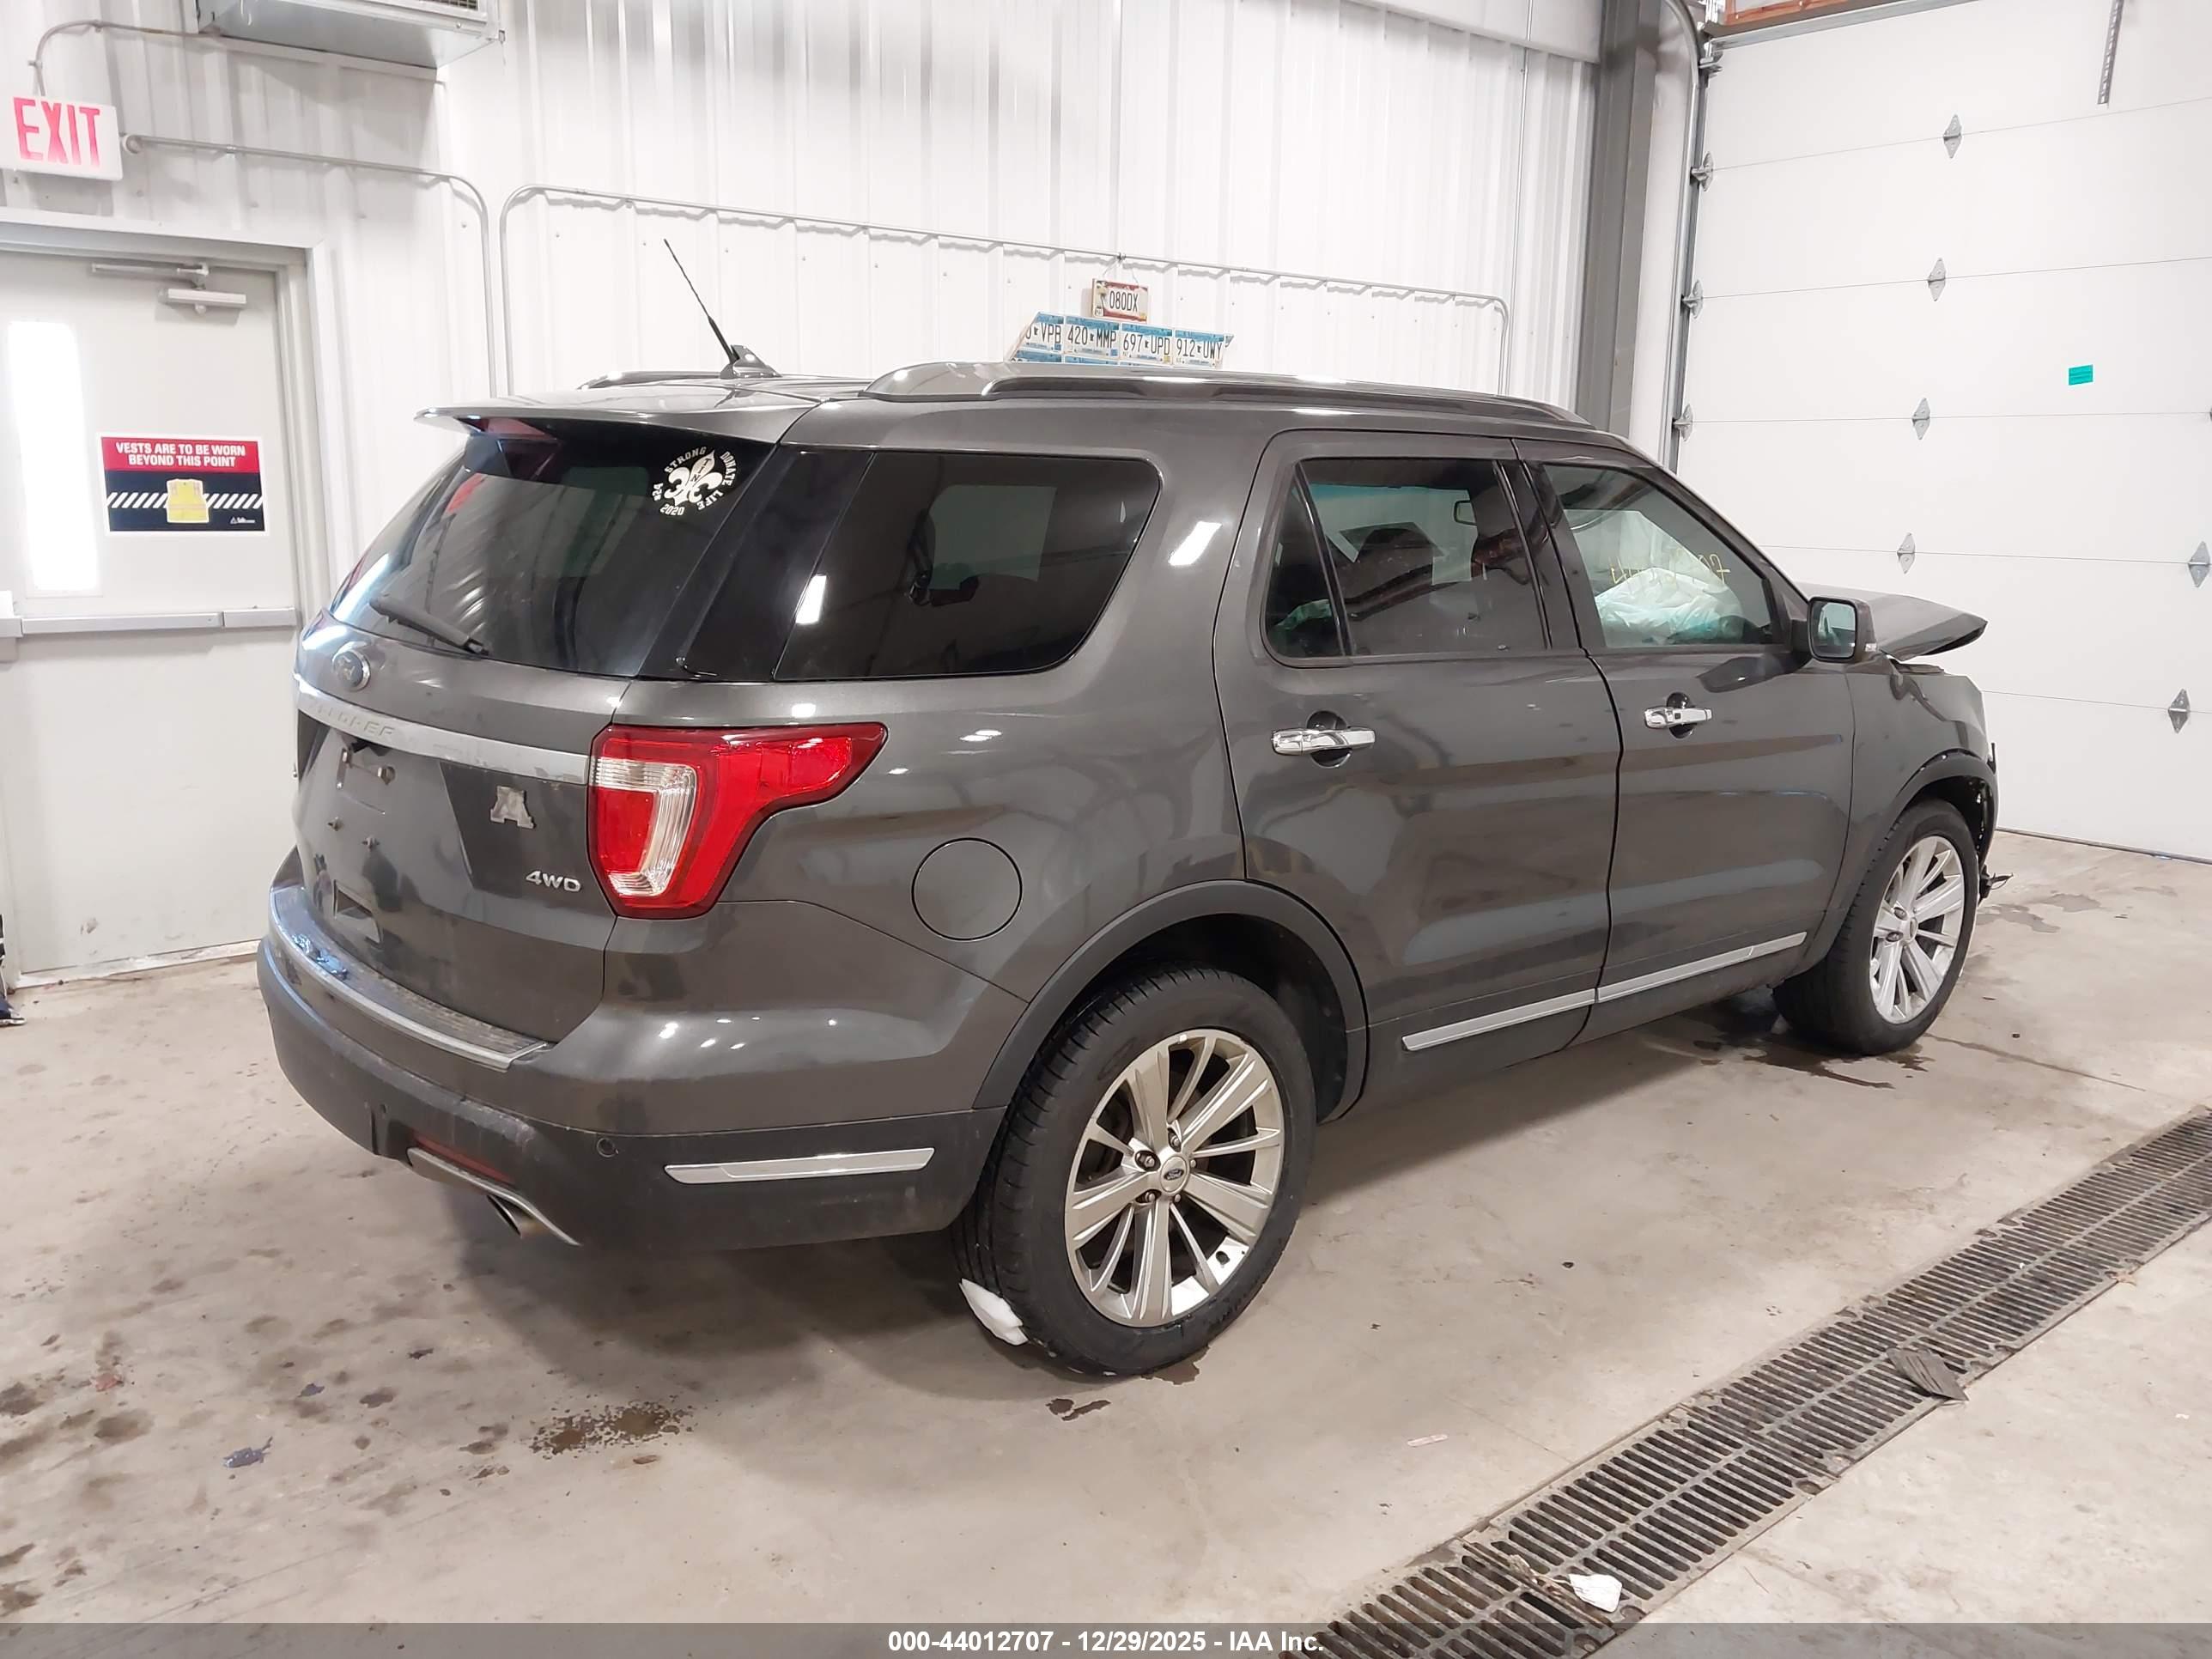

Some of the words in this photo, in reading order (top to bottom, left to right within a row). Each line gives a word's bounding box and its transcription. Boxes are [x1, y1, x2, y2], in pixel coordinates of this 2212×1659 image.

[13, 96, 100, 167] EXIT
[1109, 290, 1139, 313] 080DX
[1041, 322, 1062, 344] VPB
[1067, 325, 1088, 345] 420
[1096, 328, 1116, 349] MMP
[1123, 332, 1143, 352] 697
[1151, 335, 1170, 356] UPD
[1176, 338, 1195, 357] 912
[116, 442, 152, 454] VESTS
[155, 443, 176, 454] ARE
[178, 444, 193, 455] TO
[195, 444, 210, 455] BE
[211, 445, 246, 456] WORN
[664, 447, 707, 473] STRONG
[129, 454, 174, 465] BEYOND
[176, 455, 201, 466] THIS
[204, 456, 235, 467] POINT
[720, 451, 737, 486] DONATE
[659, 503, 685, 516] 2020
[696, 489, 724, 510] LIFE
[526, 871, 581, 892] 4WD
